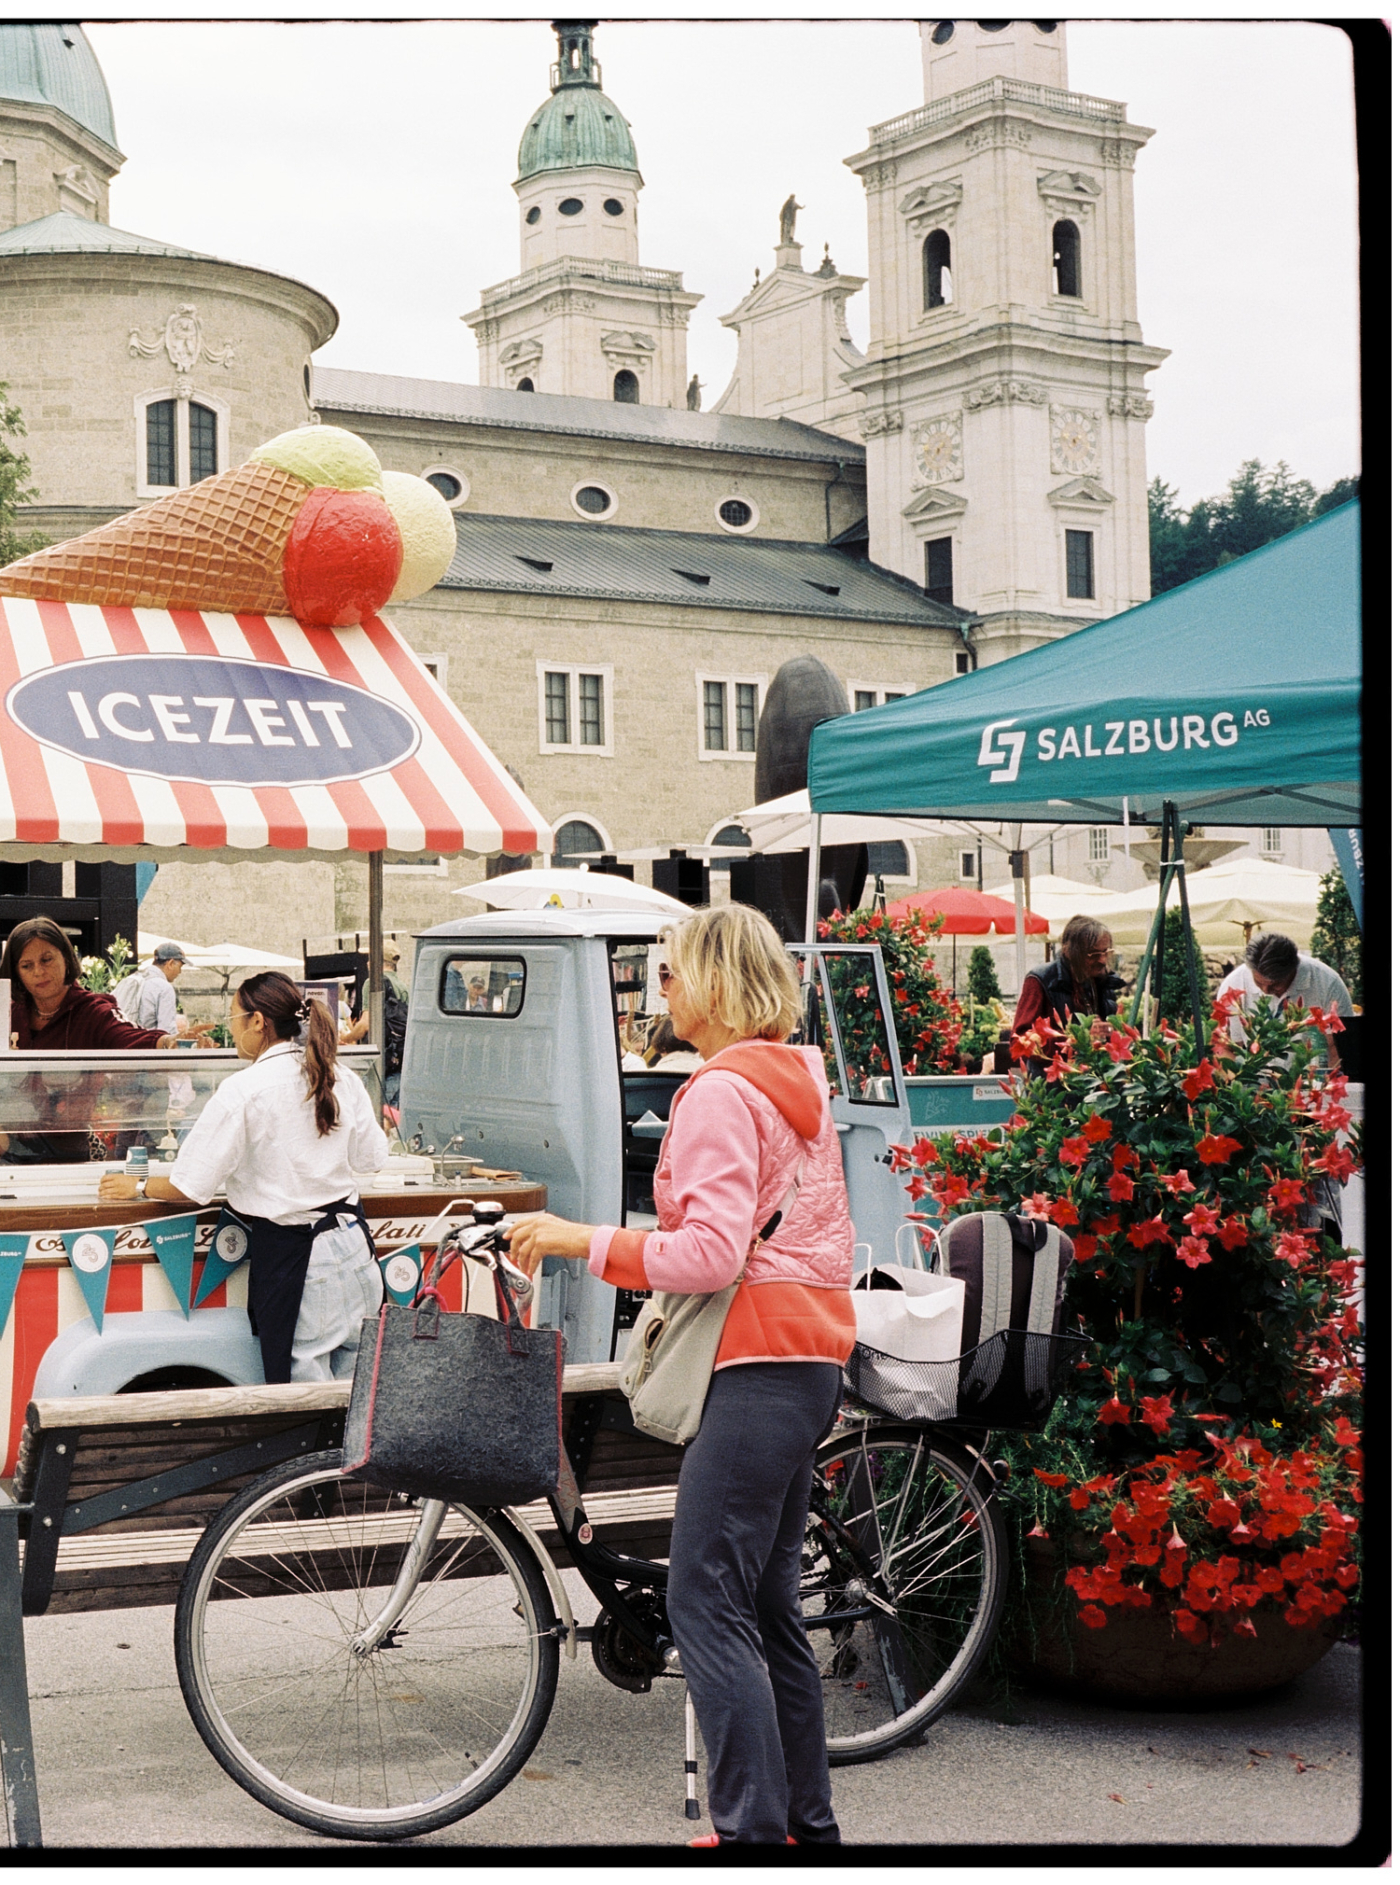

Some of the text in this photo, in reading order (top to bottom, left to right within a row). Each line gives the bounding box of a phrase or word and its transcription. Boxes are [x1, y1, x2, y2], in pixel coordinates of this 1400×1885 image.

[67, 690, 353, 749] ICEZEIT
[1037, 708, 1271, 761] SALZBURG AG
[369, 1219, 427, 1241] lati
